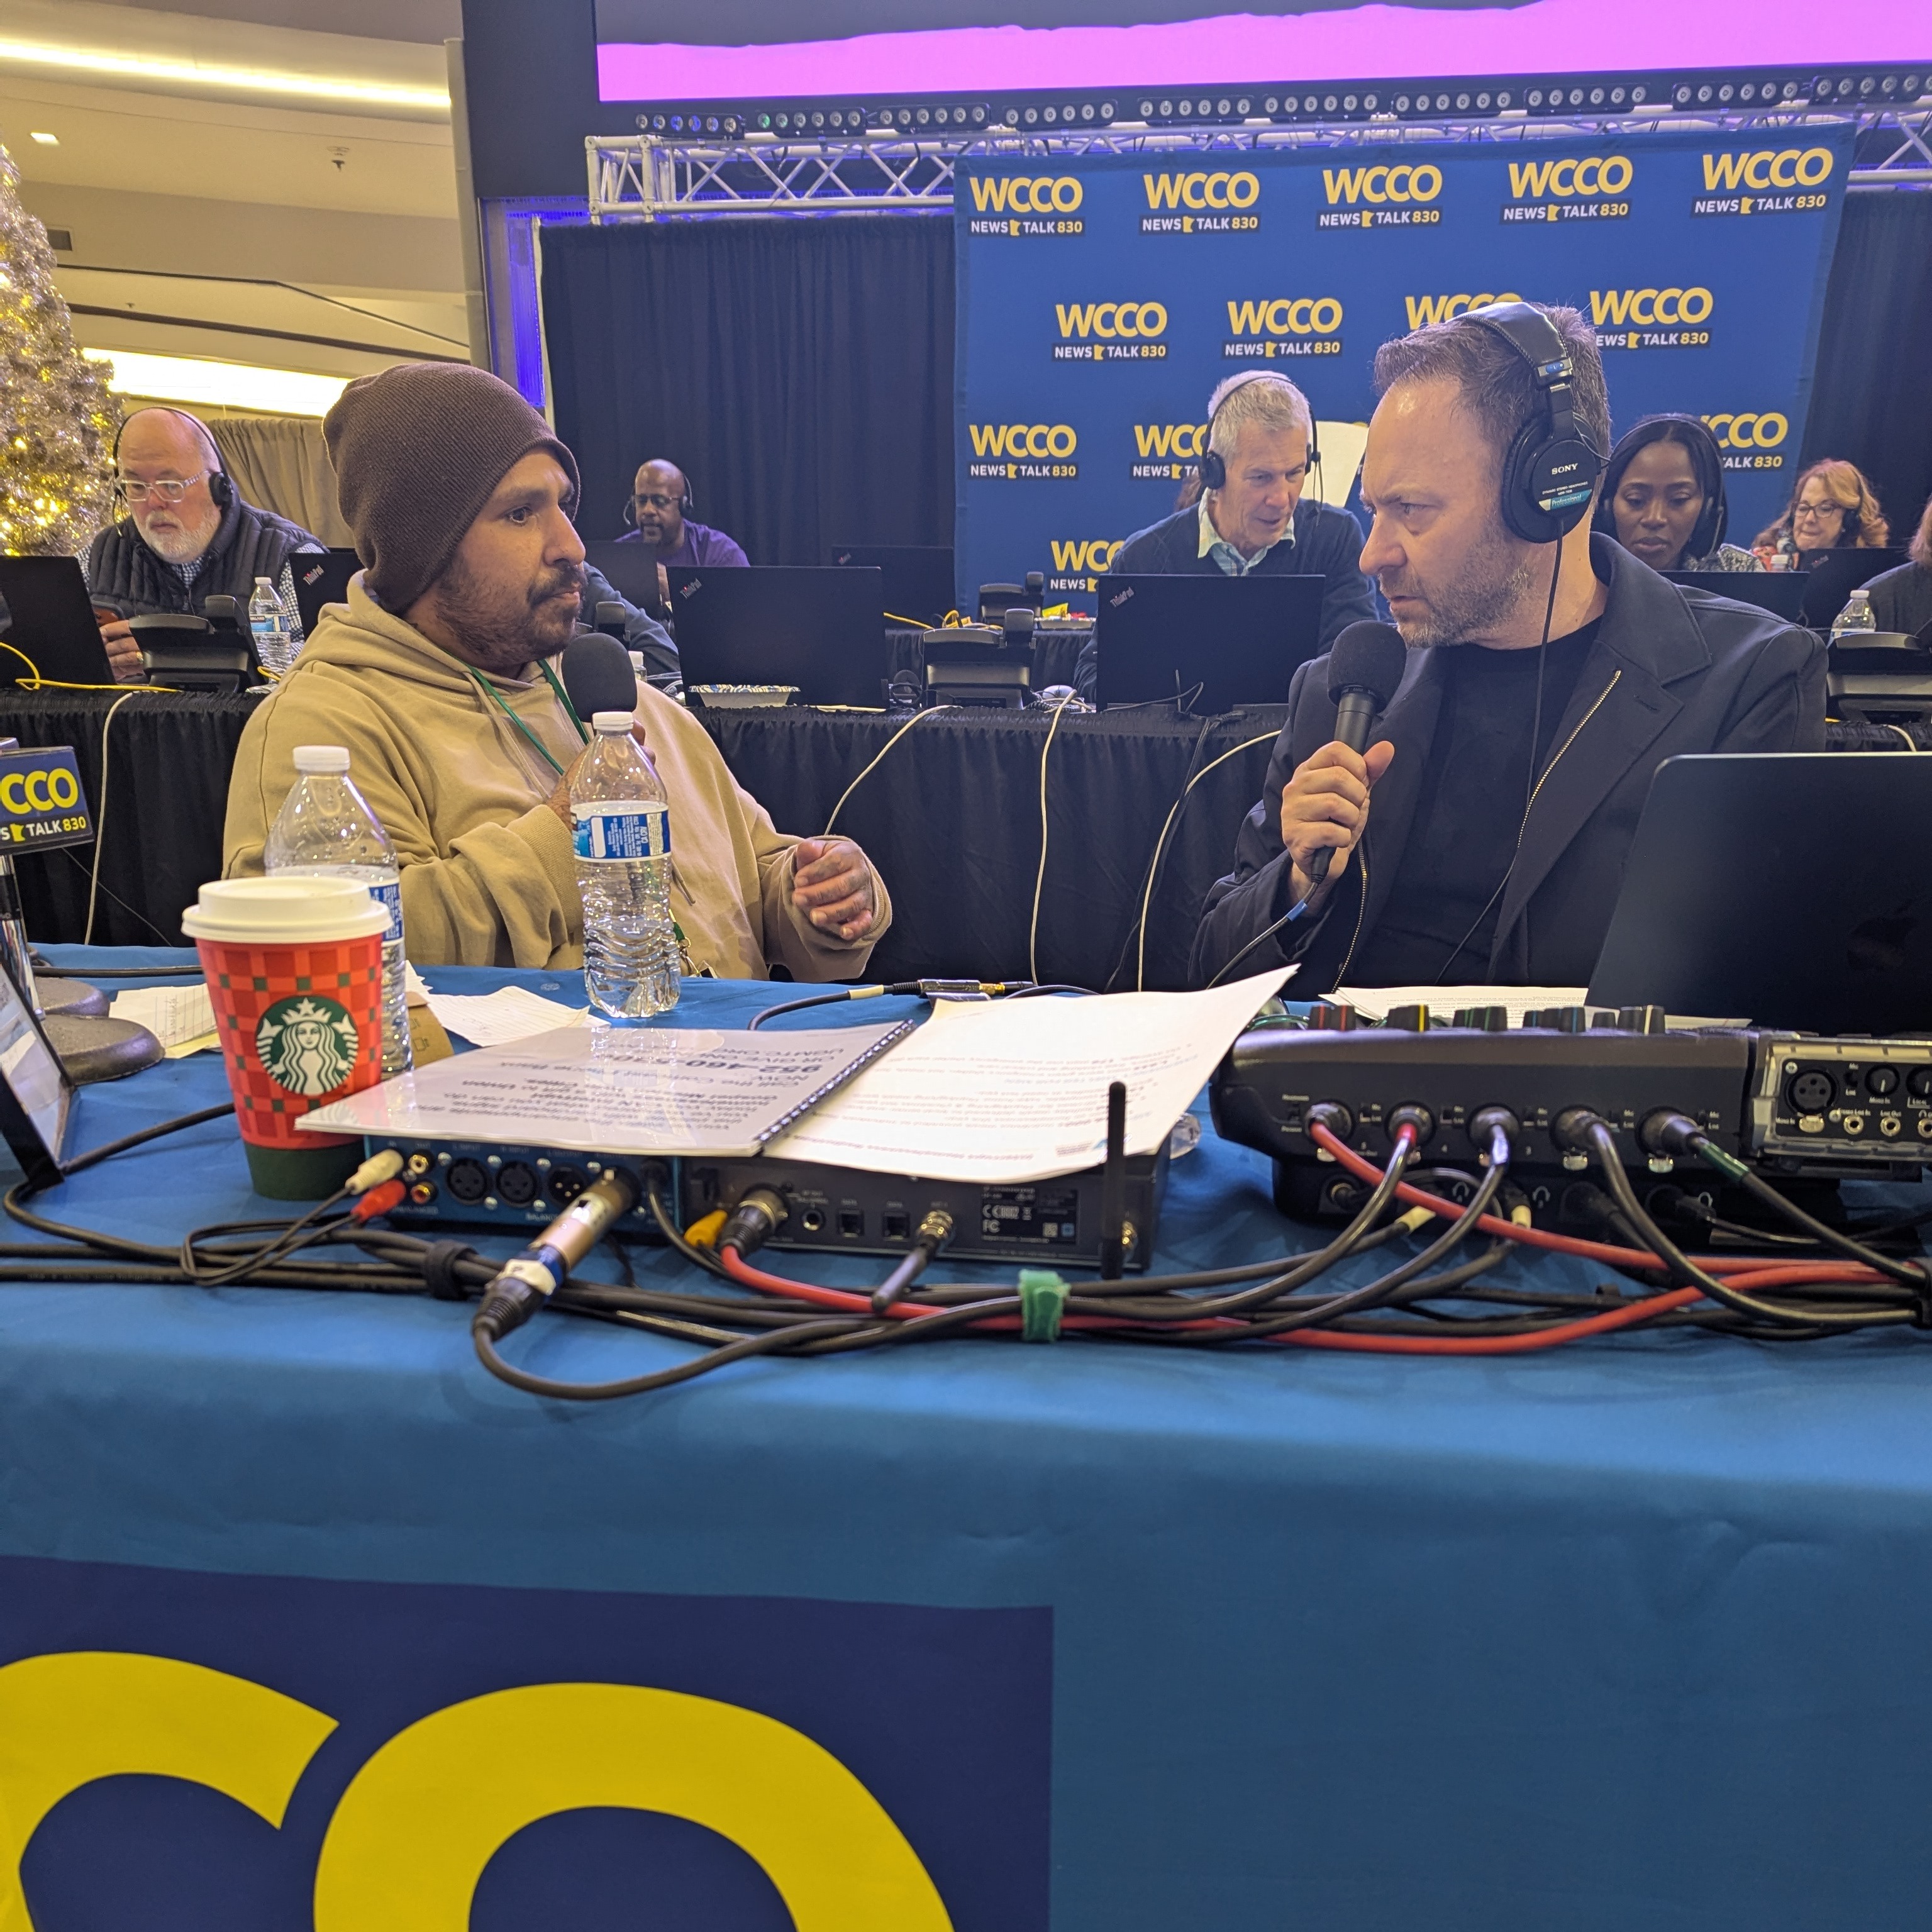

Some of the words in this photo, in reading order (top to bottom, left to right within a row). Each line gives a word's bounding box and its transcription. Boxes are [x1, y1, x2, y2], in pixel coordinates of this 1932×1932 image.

[1509, 155, 1633, 197] WCCO
[1703, 148, 1833, 189] WCCO
[1144, 172, 1259, 208] WCCO
[1323, 165, 1442, 203] WCCO
[970, 177, 1083, 212] WCCO
[1695, 200, 1739, 213] NEWS
[1757, 197, 1794, 210] TALK
[1797, 196, 1825, 208] 830
[1320, 213, 1360, 226] NEWS
[1376, 211, 1410, 223] TALK
[1413, 211, 1439, 222] 830
[1504, 207, 1546, 220] NEWS
[1563, 204, 1598, 217] TALK
[1601, 204, 1628, 215] 830
[972, 221, 1008, 233] NEWS
[1023, 221, 1055, 233] TALK
[1058, 222, 1082, 232] 830
[1143, 218, 1181, 231] NEWS
[1196, 218, 1230, 230] TALK
[1233, 217, 1257, 228] 830
[1228, 298, 1343, 334] WCCO
[1590, 287, 1713, 325] WCCO
[1056, 302, 1167, 337] WCCO
[1226, 343, 1263, 355] NEWS
[1279, 342, 1312, 354] TALK
[1314, 342, 1340, 353] 830
[1596, 334, 1626, 346] EWS
[1643, 333, 1678, 345] TALK
[1680, 333, 1708, 343] 830
[1055, 347, 1092, 358] NEWS
[1107, 346, 1138, 357] TALK
[1141, 346, 1165, 357] 830
[1701, 412, 1789, 448] CCO
[969, 425, 1077, 457] WCCO
[1134, 424, 1208, 458] WCC
[971, 465, 1006, 475] NEWS
[1020, 465, 1050, 476] TALK
[1053, 466, 1075, 476] 830
[1133, 465, 1170, 476] NEWS
[1552, 463, 1578, 475] SONY
[1723, 457, 1753, 468] ALK
[1755, 457, 1782, 467] 830
[1051, 579, 1085, 589] NEWS
[1109, 586, 1135, 608] ThinkPad
[0, 767, 79, 814] CCO
[25, 819, 62, 836] TALK
[63, 816, 86, 831] 830
